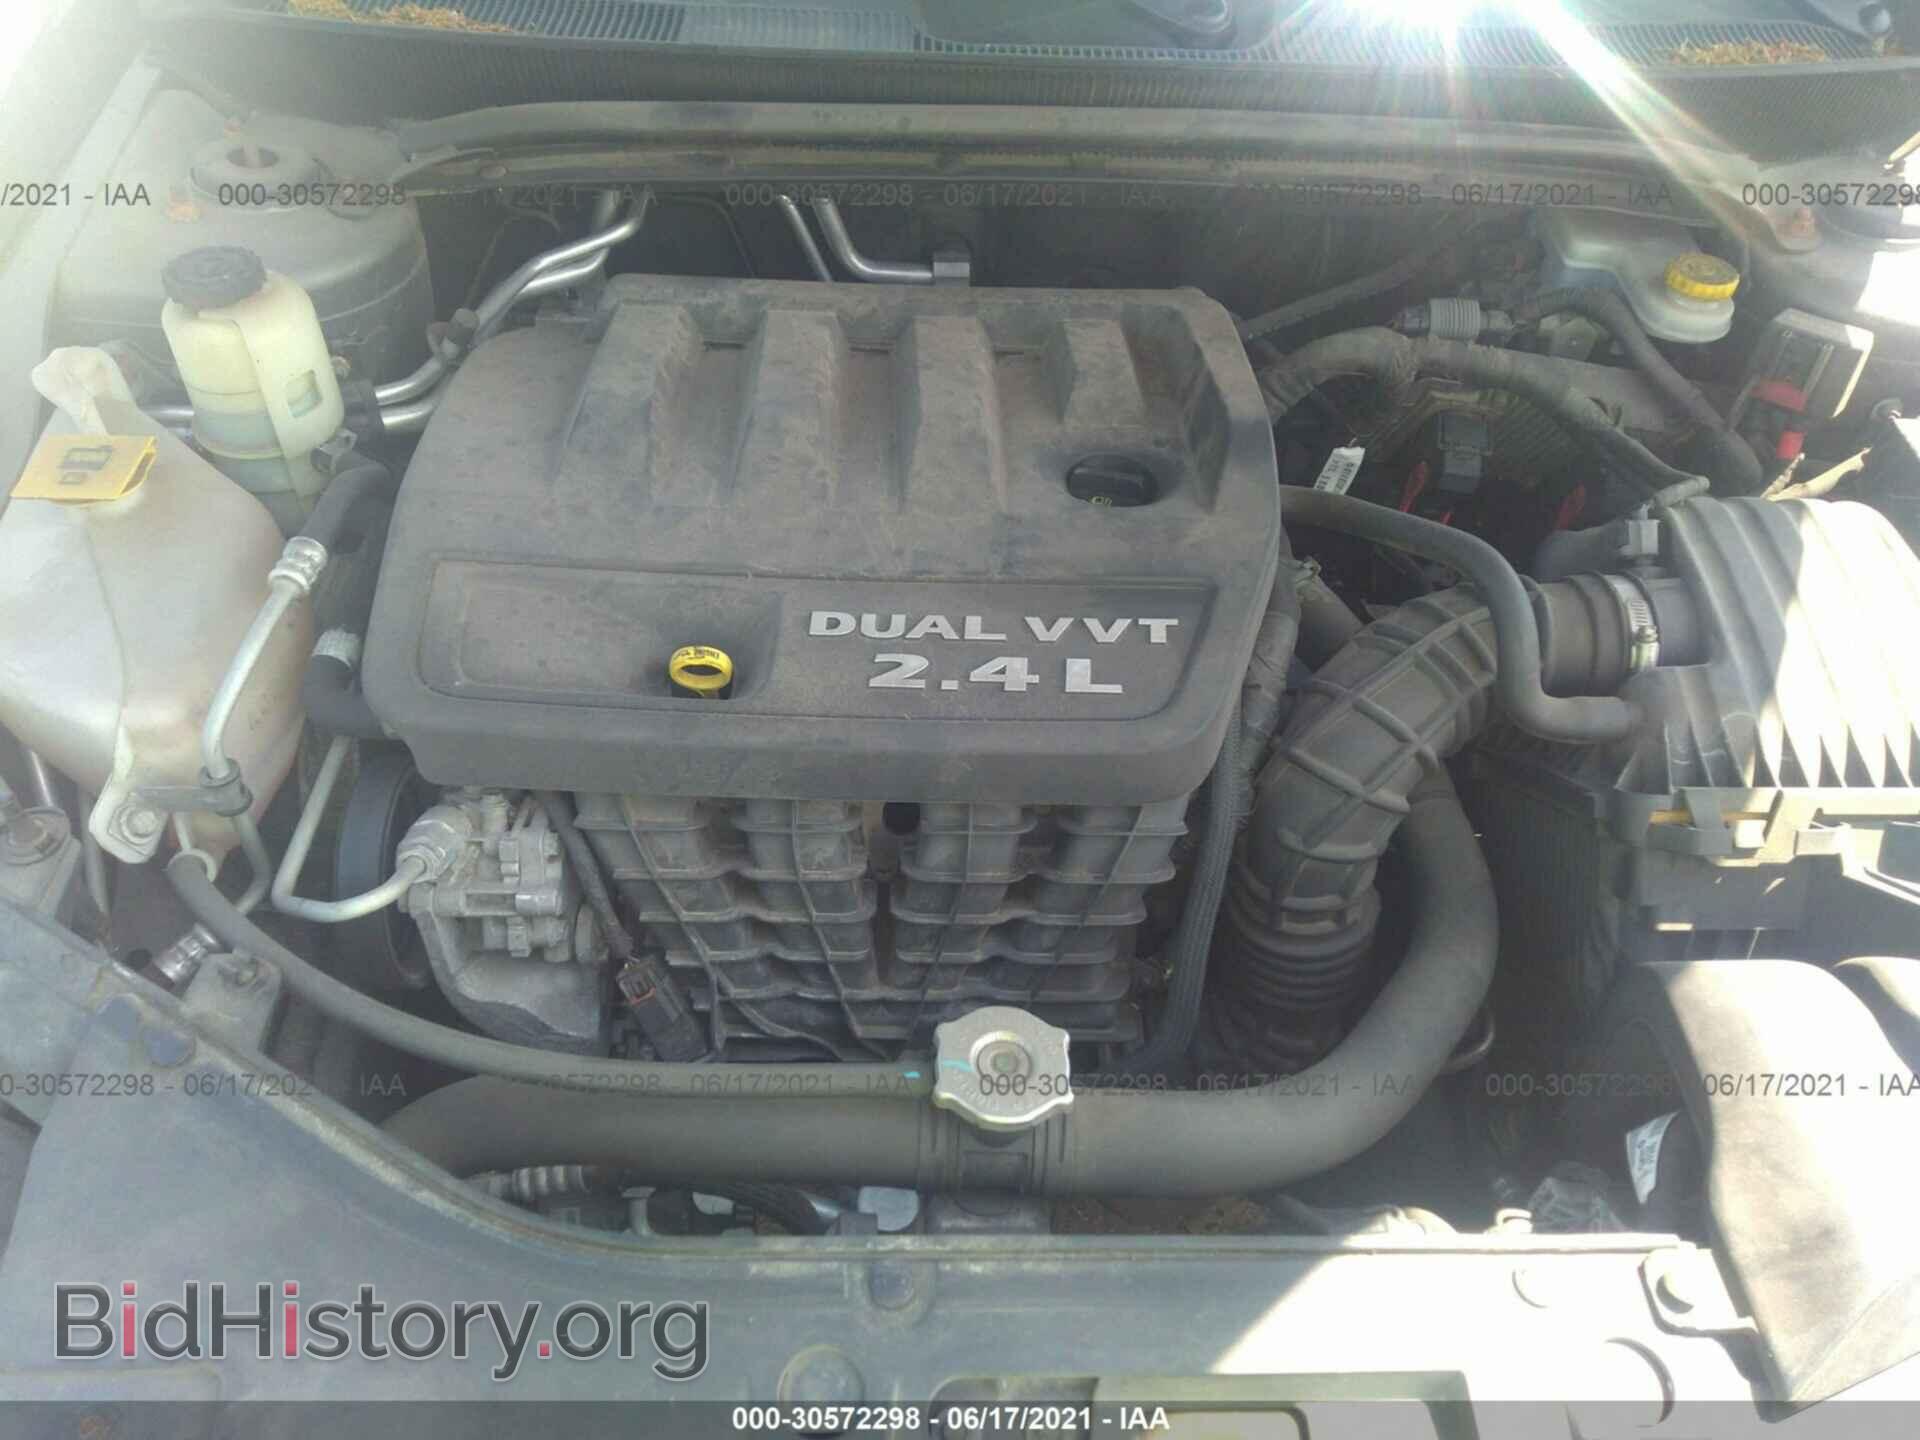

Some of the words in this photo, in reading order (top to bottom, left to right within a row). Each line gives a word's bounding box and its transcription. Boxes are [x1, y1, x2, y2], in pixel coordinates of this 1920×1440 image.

[809, 611, 1007, 641] DUAL
[1024, 616, 1179, 643] VVT
[868, 653, 1040, 692] 2.4
[1065, 658, 1123, 694] L
